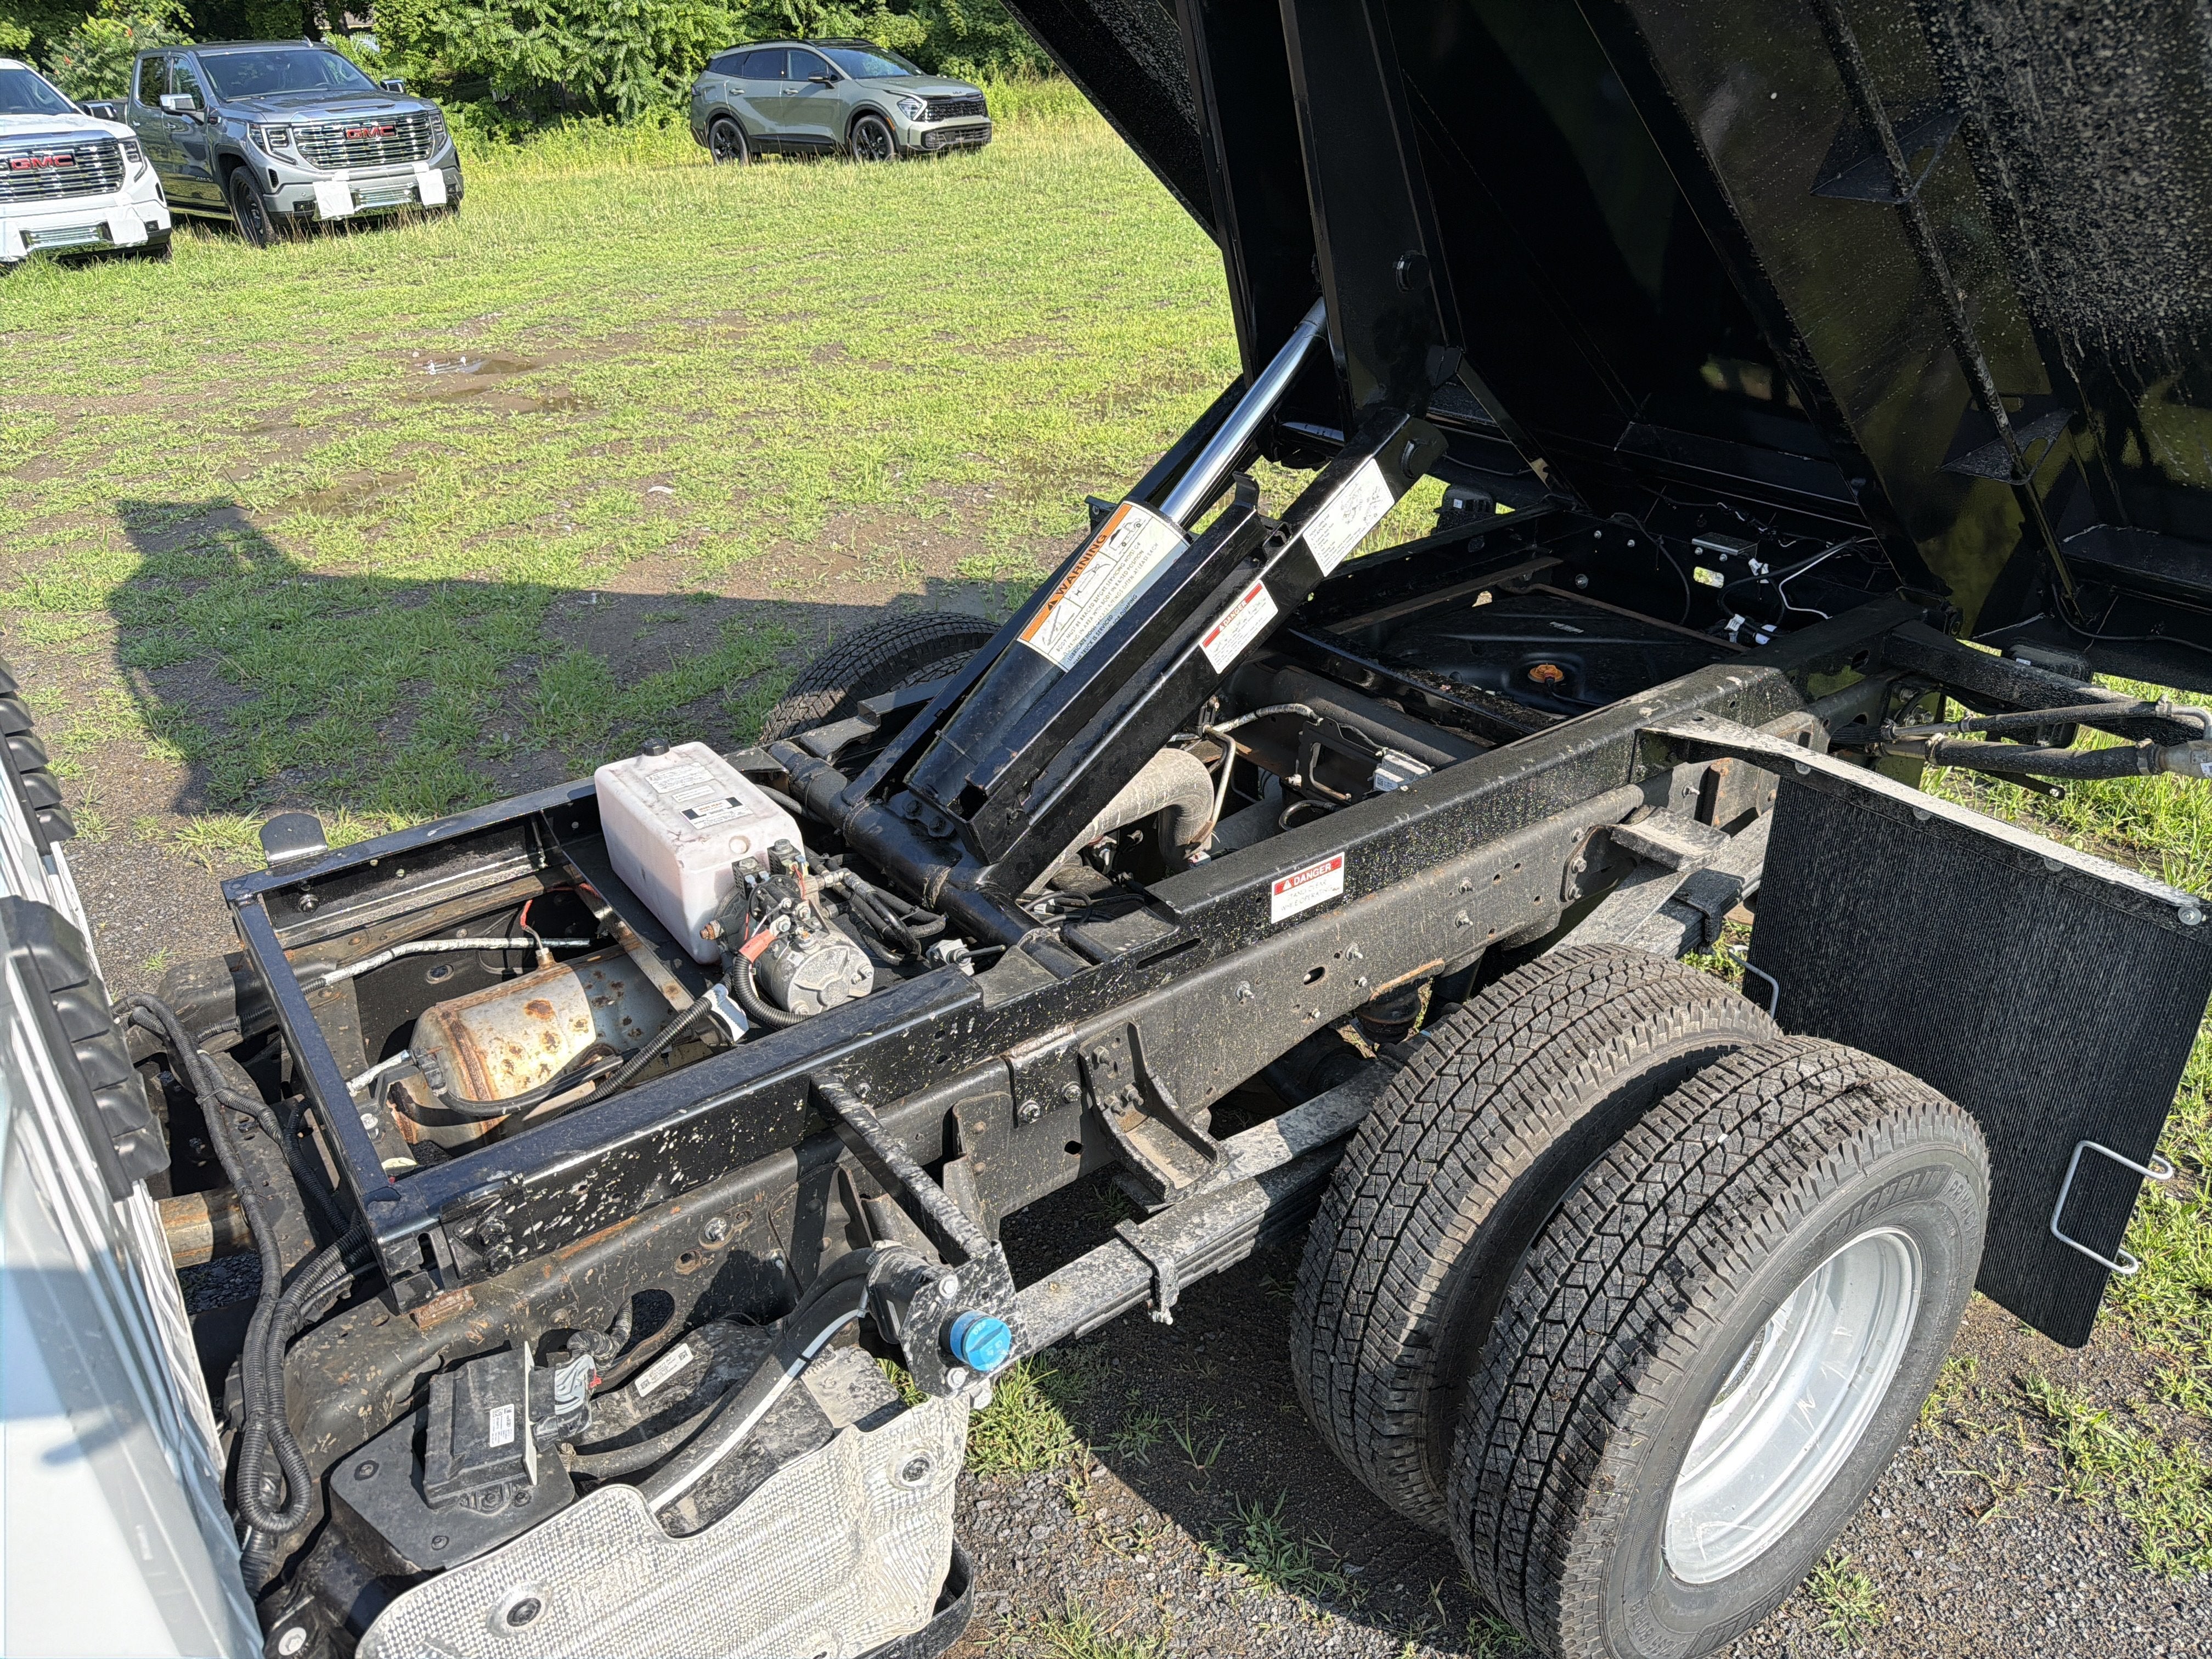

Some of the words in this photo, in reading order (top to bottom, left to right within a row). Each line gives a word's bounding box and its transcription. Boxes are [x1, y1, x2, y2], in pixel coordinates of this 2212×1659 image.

[346, 126, 396, 140] GMC
[10, 154, 74, 171] GMC
[1055, 532, 1108, 598] WARNING
[1065, 626, 1077, 639] MUST
[1079, 601, 1095, 621] BRACED
[1105, 562, 1126, 586] SERVICING
[1082, 615, 1094, 629] AREA
[1100, 591, 1112, 605] BODY
[1126, 549, 1144, 571] POSITION
[1119, 593, 1138, 616] DUMPING
[1223, 600, 1248, 627] DANGER
[1066, 637, 1087, 662] LUBRICATE
[1081, 639, 1094, 655] TRUCK
[1095, 613, 1114, 636] SERVICED
[1293, 863, 1331, 886] DANGER
[1822, 1171, 1948, 1248] MICHELIN
[1944, 1179, 1978, 1232] PRIMACY
